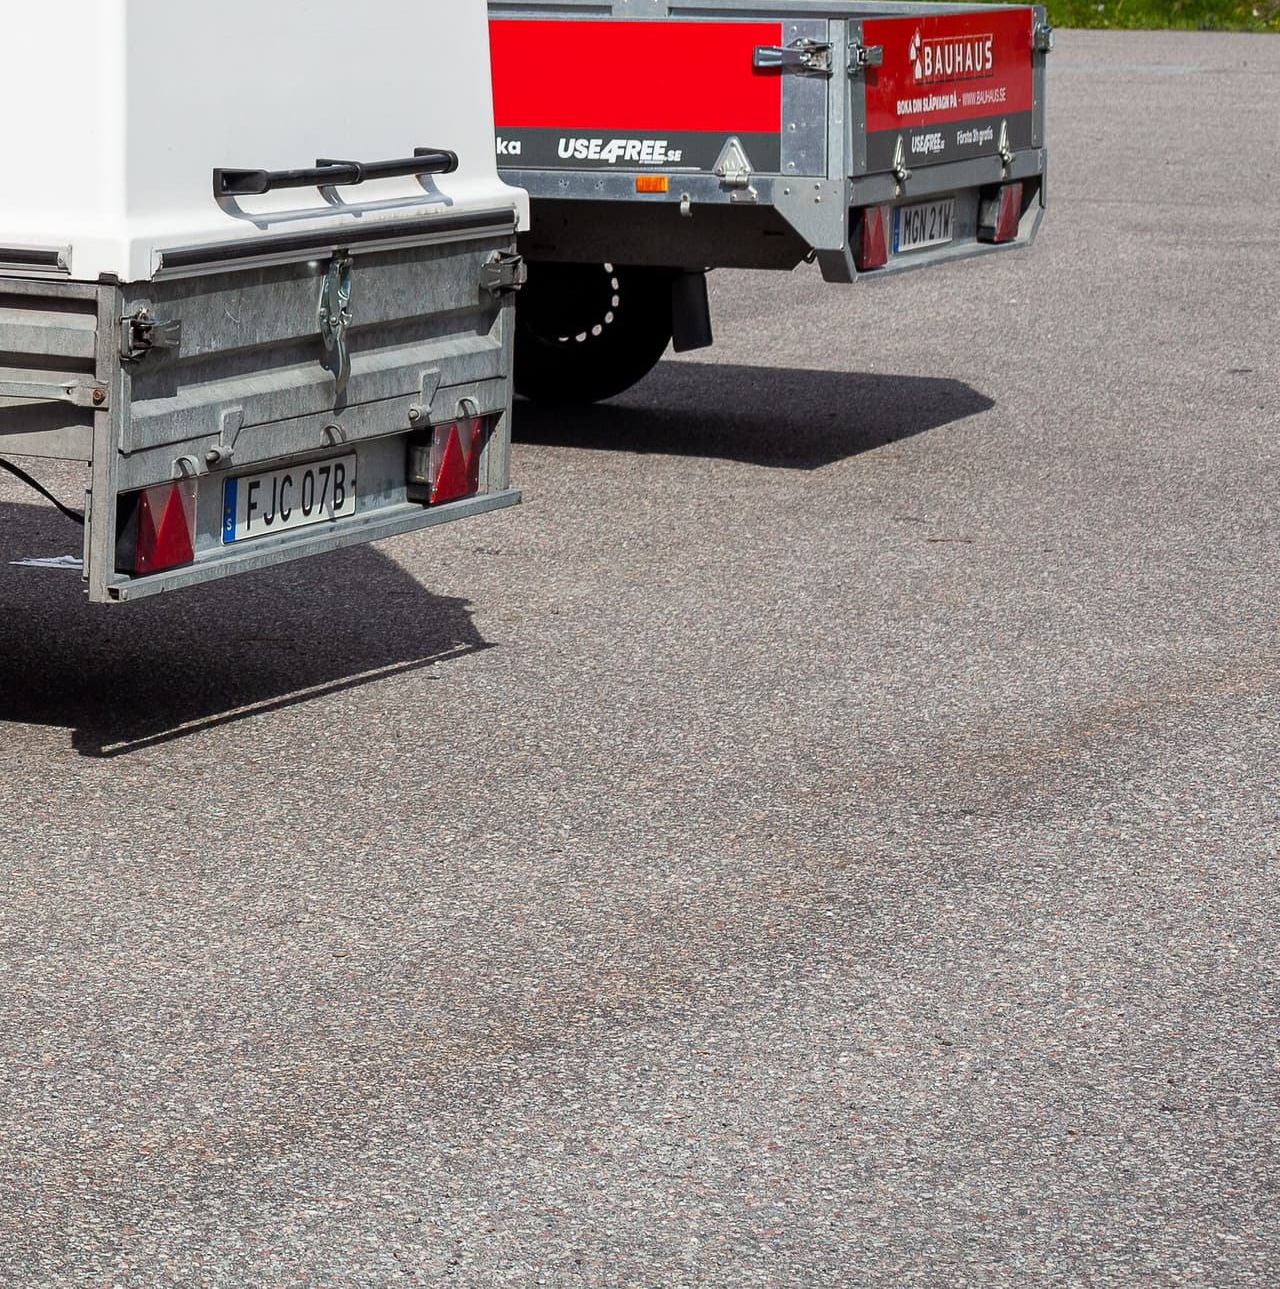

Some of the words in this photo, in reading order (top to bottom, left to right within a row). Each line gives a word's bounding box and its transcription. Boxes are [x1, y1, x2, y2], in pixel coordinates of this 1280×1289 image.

[924, 40, 993, 76] BAUHAUS
[903, 208, 926, 246] MGN
[929, 203, 951, 240] 21W
[246, 474, 293, 531] FJC
[302, 462, 346, 517] 07B
